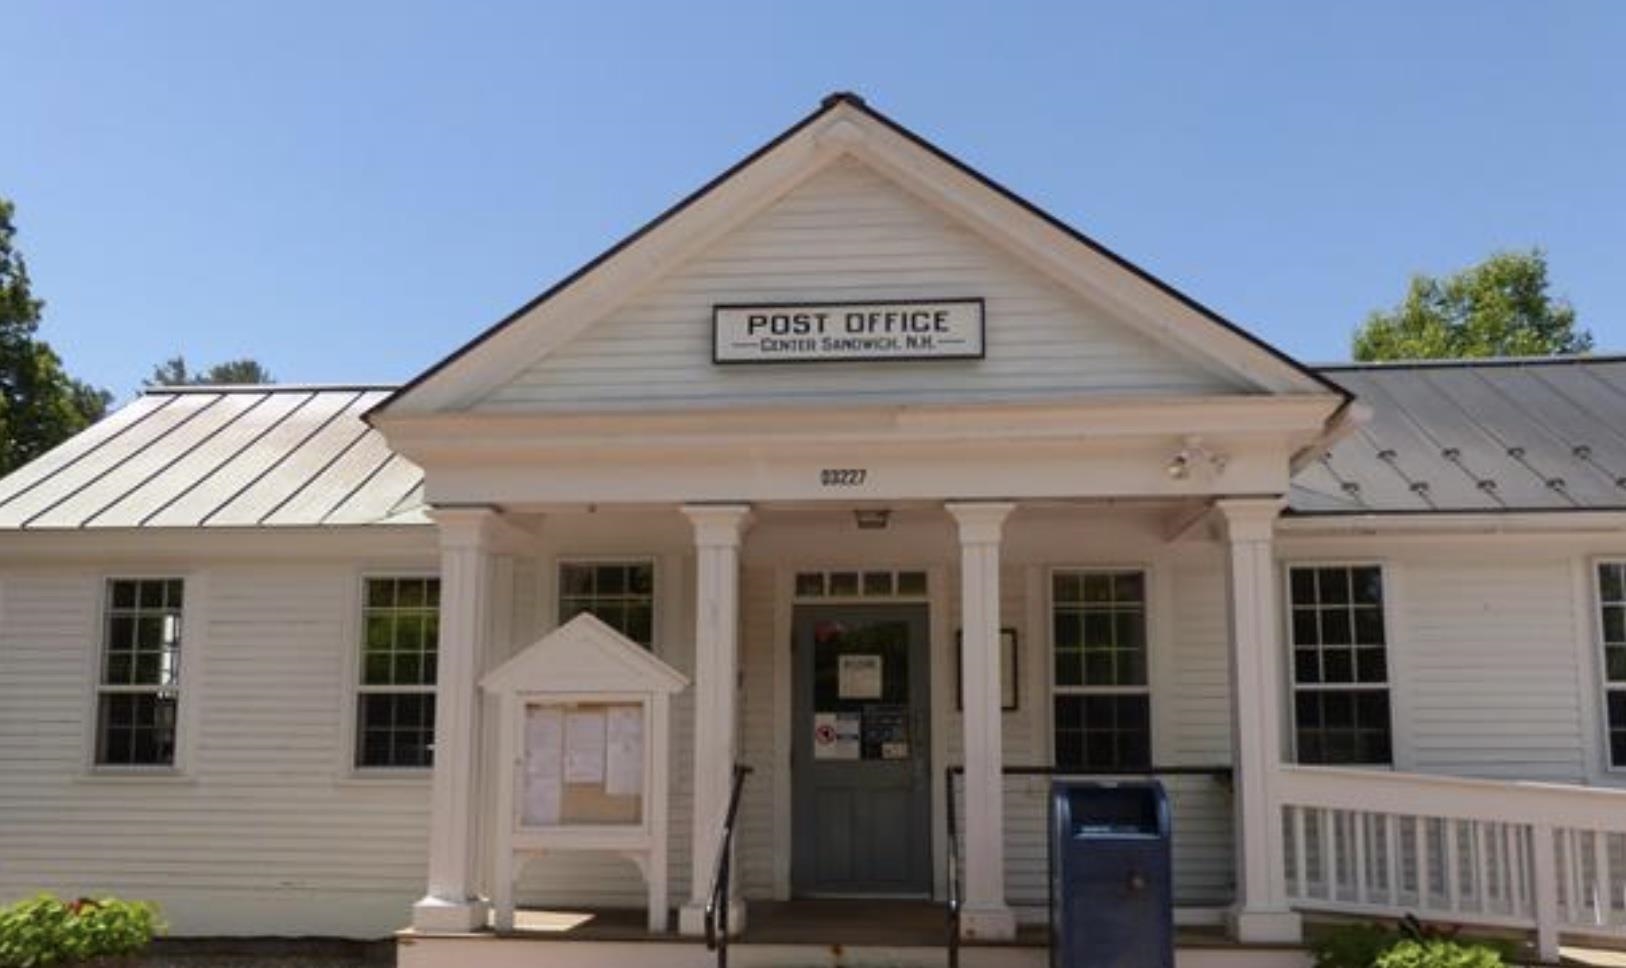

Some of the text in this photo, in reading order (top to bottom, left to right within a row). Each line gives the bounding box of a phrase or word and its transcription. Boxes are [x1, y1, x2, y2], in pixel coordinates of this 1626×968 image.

[747, 310, 949, 335] POST OFFICE
[760, 336, 816, 352] CENTER
[906, 332, 936, 349] N.H.
[820, 469, 867, 486] 03227
